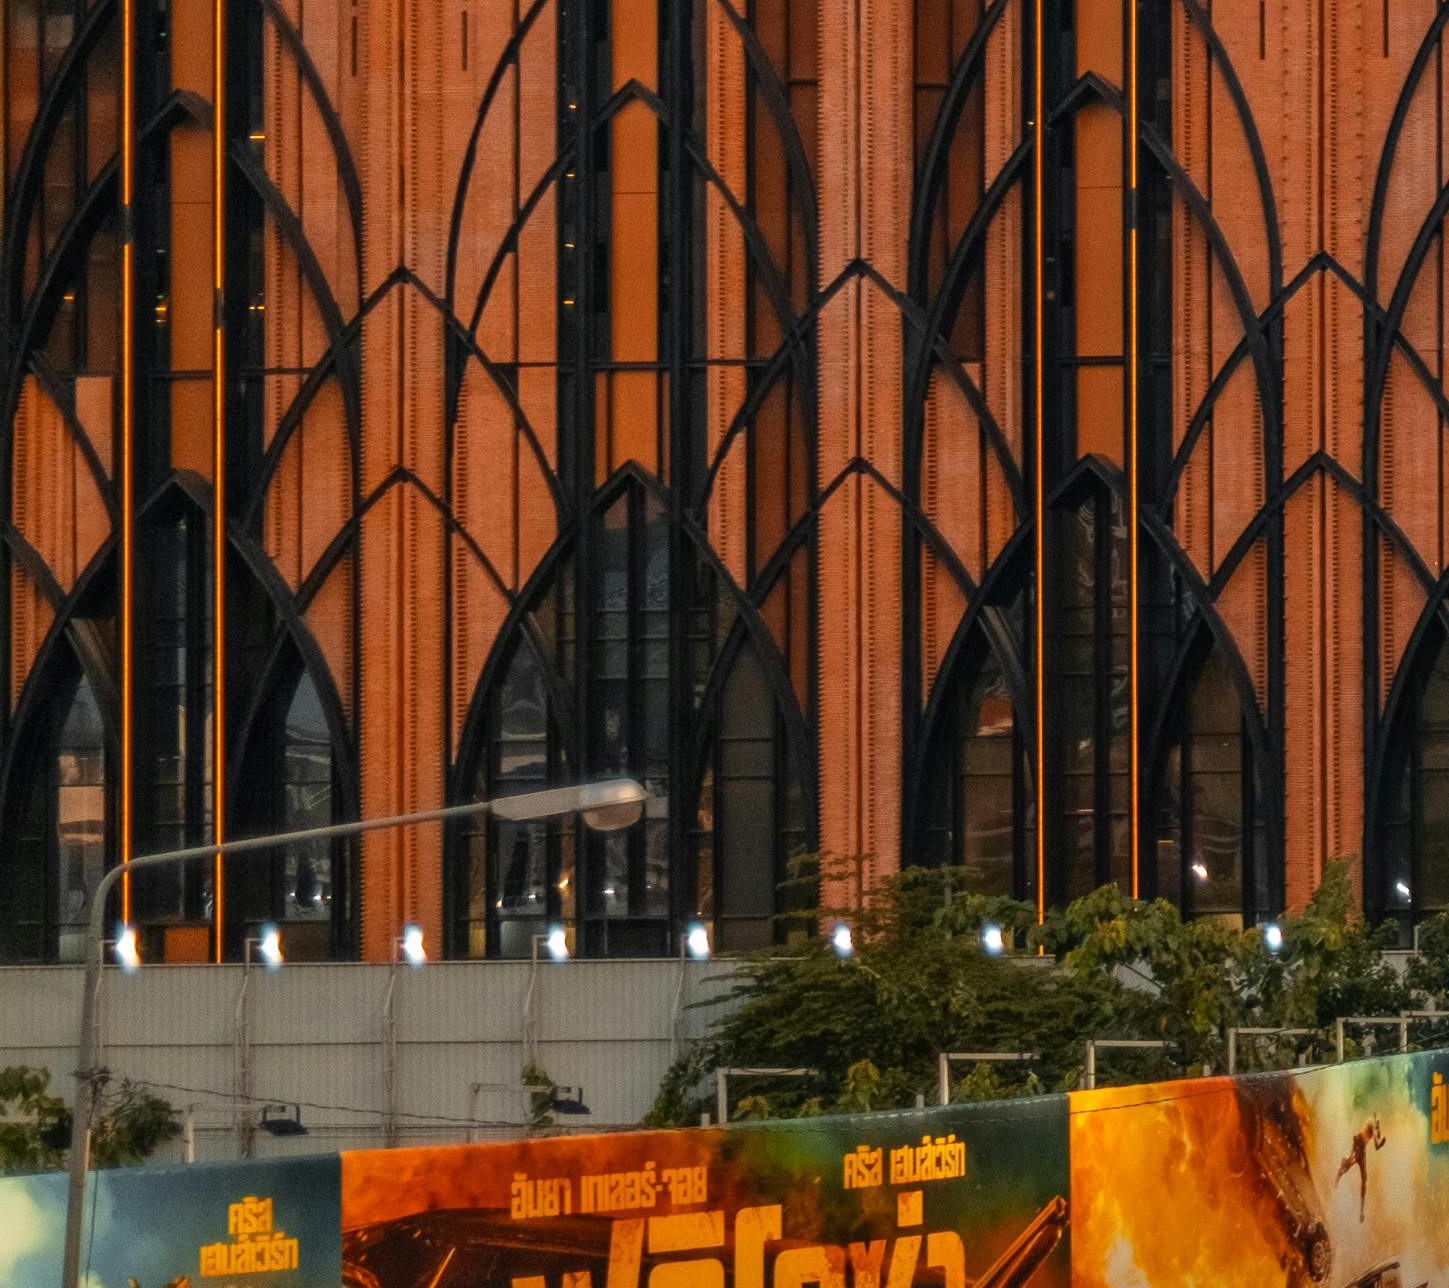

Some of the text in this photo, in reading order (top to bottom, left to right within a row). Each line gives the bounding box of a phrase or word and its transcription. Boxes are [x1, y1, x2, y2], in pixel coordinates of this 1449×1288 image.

[843, 1145, 882, 1189] คริส
[510, 1160, 707, 1220] อันยา เทเลอร์-จอย
[228, 1196, 273, 1235] คริส
